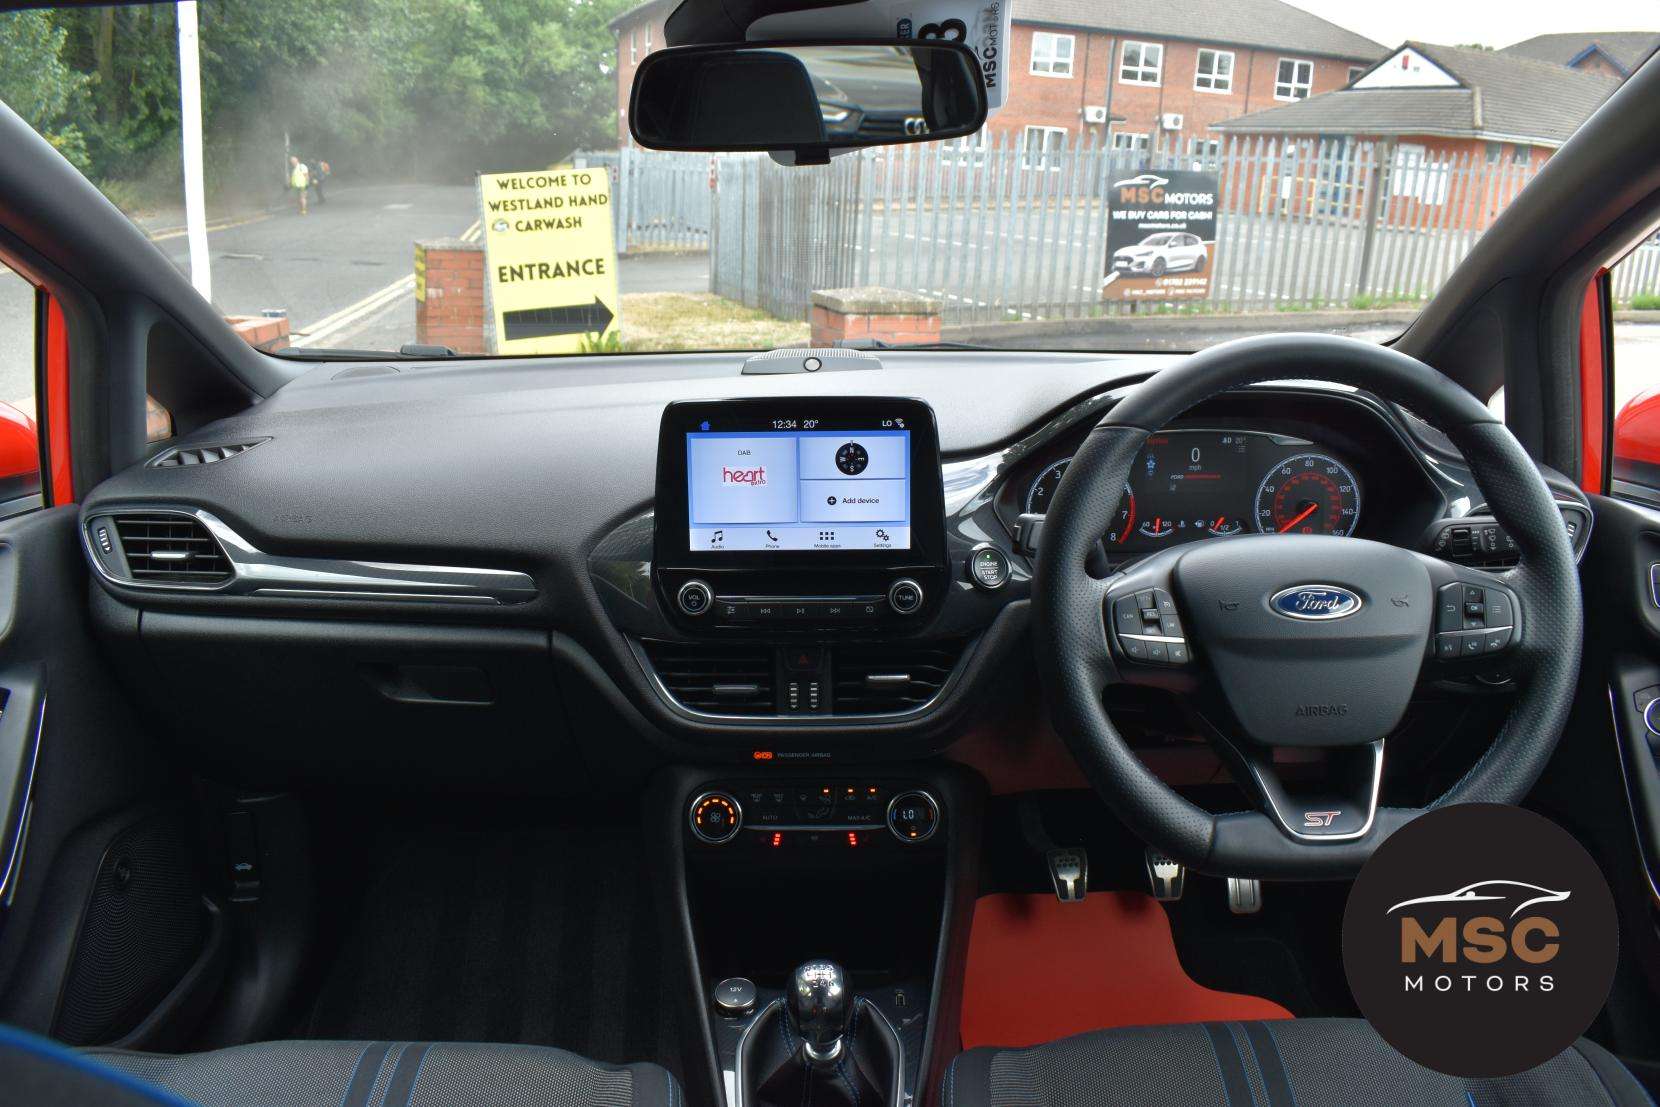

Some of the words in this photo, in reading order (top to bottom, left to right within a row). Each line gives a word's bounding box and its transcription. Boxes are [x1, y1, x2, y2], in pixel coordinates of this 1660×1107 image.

[983, 46, 998, 88] MSC
[497, 175, 567, 190] WELCOME
[572, 173, 592, 185] TO
[488, 196, 564, 213] WESTLAND
[568, 194, 608, 208] HAND
[1120, 187, 1164, 204] MSC
[1164, 192, 1214, 206] MOTORS
[515, 216, 583, 232] CARWASH
[497, 258, 606, 283] ENTRANCE
[772, 420, 797, 429] 12:34
[803, 419, 819, 429] 20°
[1191, 447, 1200, 462] 0
[723, 467, 765, 483] heart
[1055, 470, 1061, 479] 3
[1281, 467, 1291, 475] 60
[1037, 487, 1044, 496] 2
[1340, 485, 1351, 493] 120
[842, 496, 856, 504] Add
[857, 496, 880, 504] device
[1121, 510, 1128, 519] 7
[1110, 533, 1117, 541] 8
[1295, 591, 1340, 610] Ford
[1295, 704, 1350, 717] AIRBAG
[1304, 811, 1341, 826] ST
